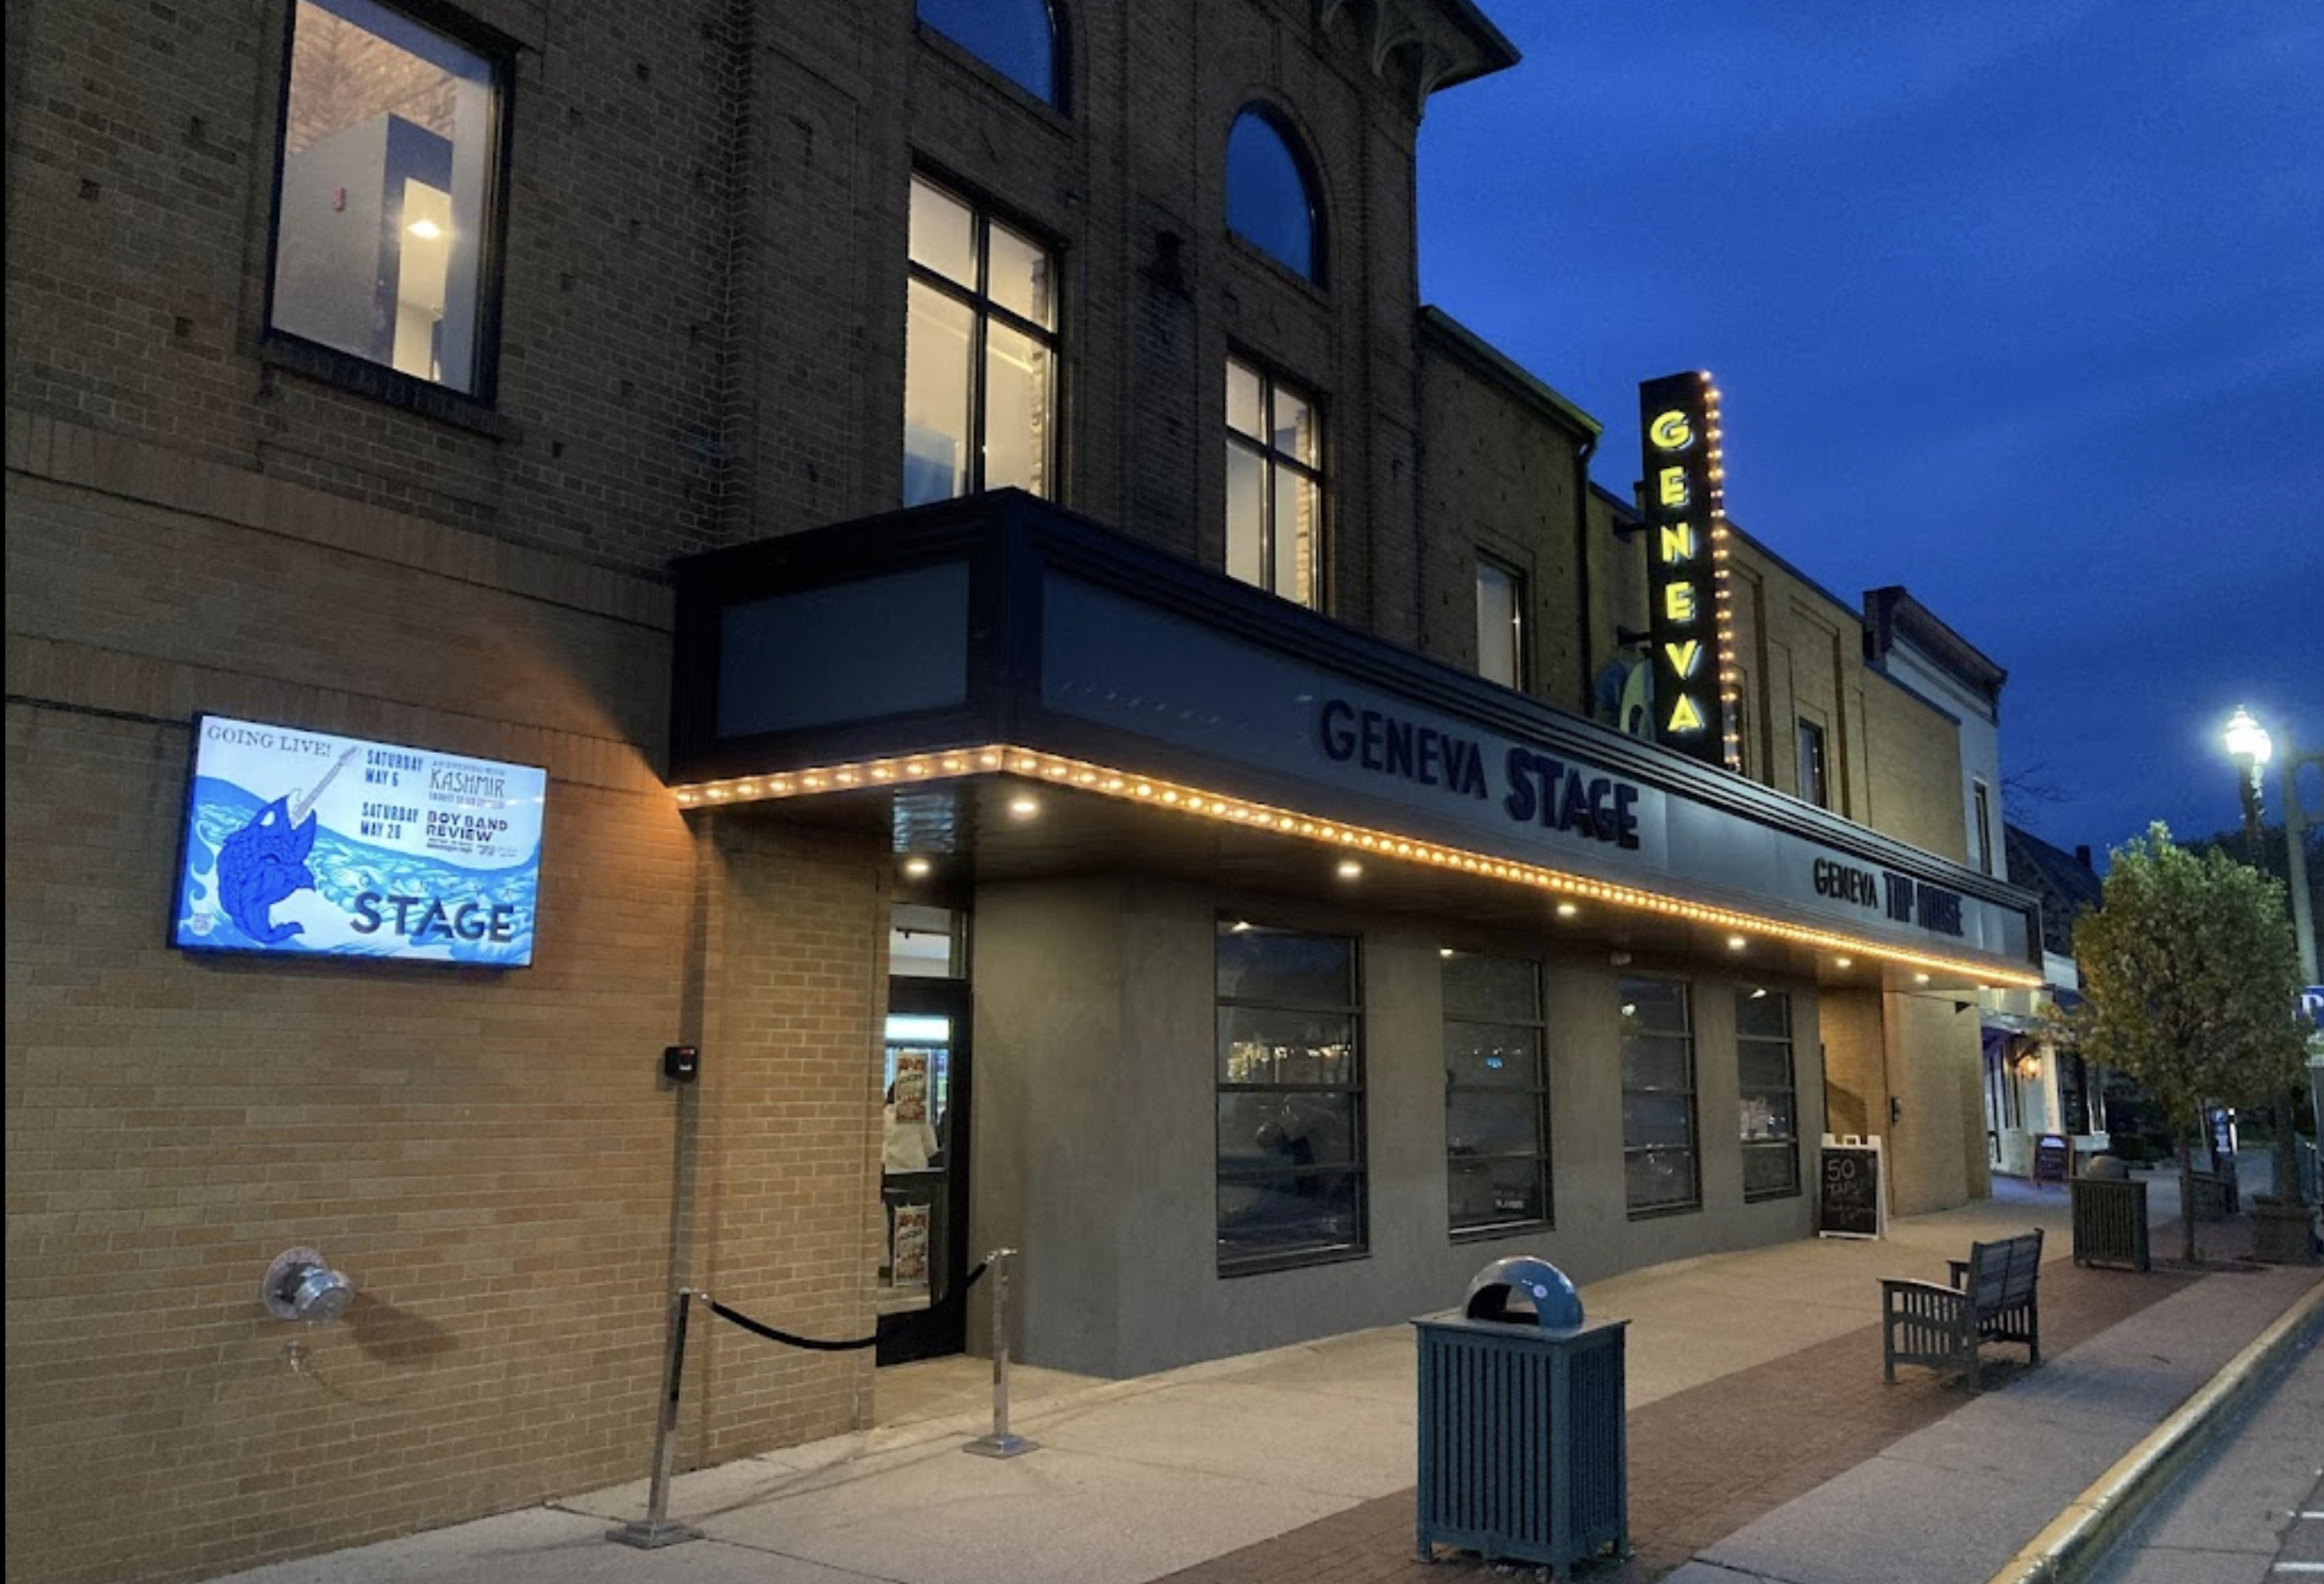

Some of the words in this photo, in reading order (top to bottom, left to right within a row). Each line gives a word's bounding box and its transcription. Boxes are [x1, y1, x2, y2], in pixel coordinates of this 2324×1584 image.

[1649, 409, 1702, 733] GENEVA
[206, 725, 273, 749] GOING
[279, 735, 331, 757] LIVE!
[366, 749, 424, 772] SATURDAY
[365, 767, 389, 786] MAY
[429, 767, 505, 798] KASHMIR
[1322, 699, 1489, 798] GENEVA
[1505, 746, 1640, 850] STAGE
[361, 801, 419, 824] SATURDAY
[427, 810, 461, 826] BOY
[465, 814, 508, 832] BAND
[360, 819, 384, 837] MAY
[427, 824, 494, 842] REVIEW
[1813, 857, 1879, 909] GENEVA
[350, 891, 515, 943] STAGE
